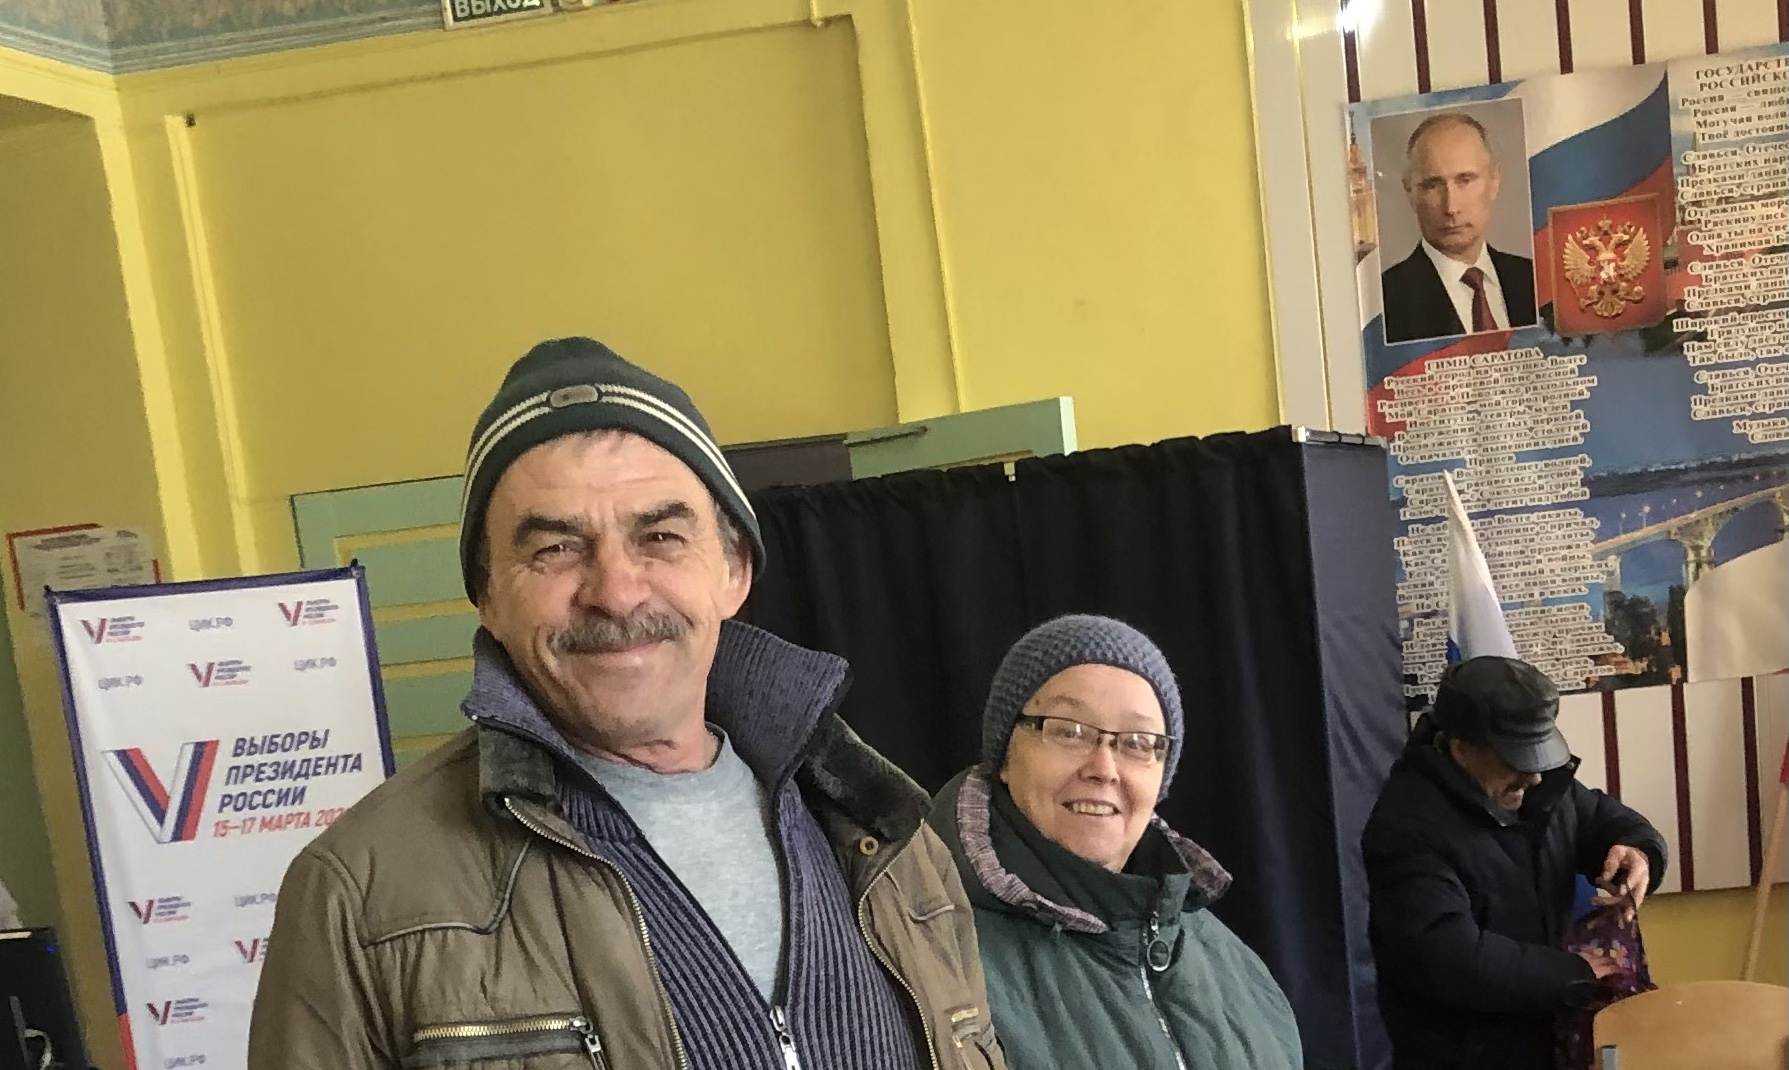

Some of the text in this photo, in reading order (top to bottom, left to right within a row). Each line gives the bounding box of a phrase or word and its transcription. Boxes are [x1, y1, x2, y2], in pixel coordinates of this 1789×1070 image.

[1681, 95, 1724, 106] Россия
[1692, 106, 1736, 117] Россия
[1695, 116, 1752, 129] Могучая
[1674, 314, 1737, 329] Широкий
[1686, 343, 1712, 352] Нам
[1716, 339, 1744, 349] силу
[1426, 349, 1542, 370] ГИМН САРАТОВА
[1690, 354, 1712, 363] Так
[1386, 373, 1434, 387] Русский
[1438, 370, 1470, 380] город
[1550, 356, 1584, 366] Волге
[1379, 396, 1444, 409] Расцветает
[1387, 409, 1412, 419] Мой
[1417, 404, 1466, 416] Саратов
[1479, 398, 1501, 408] мой
[1505, 395, 1538, 405] город
[1735, 419, 1786, 431] Музыка
[1456, 468, 1490, 478] Волга
[232, 729, 330, 758] ВЫБОРЫ
[224, 753, 362, 786] ПРЕЗИДЕНТА
[218, 786, 307, 813] РОССИИ
[259, 811, 311, 833] МАРТА
